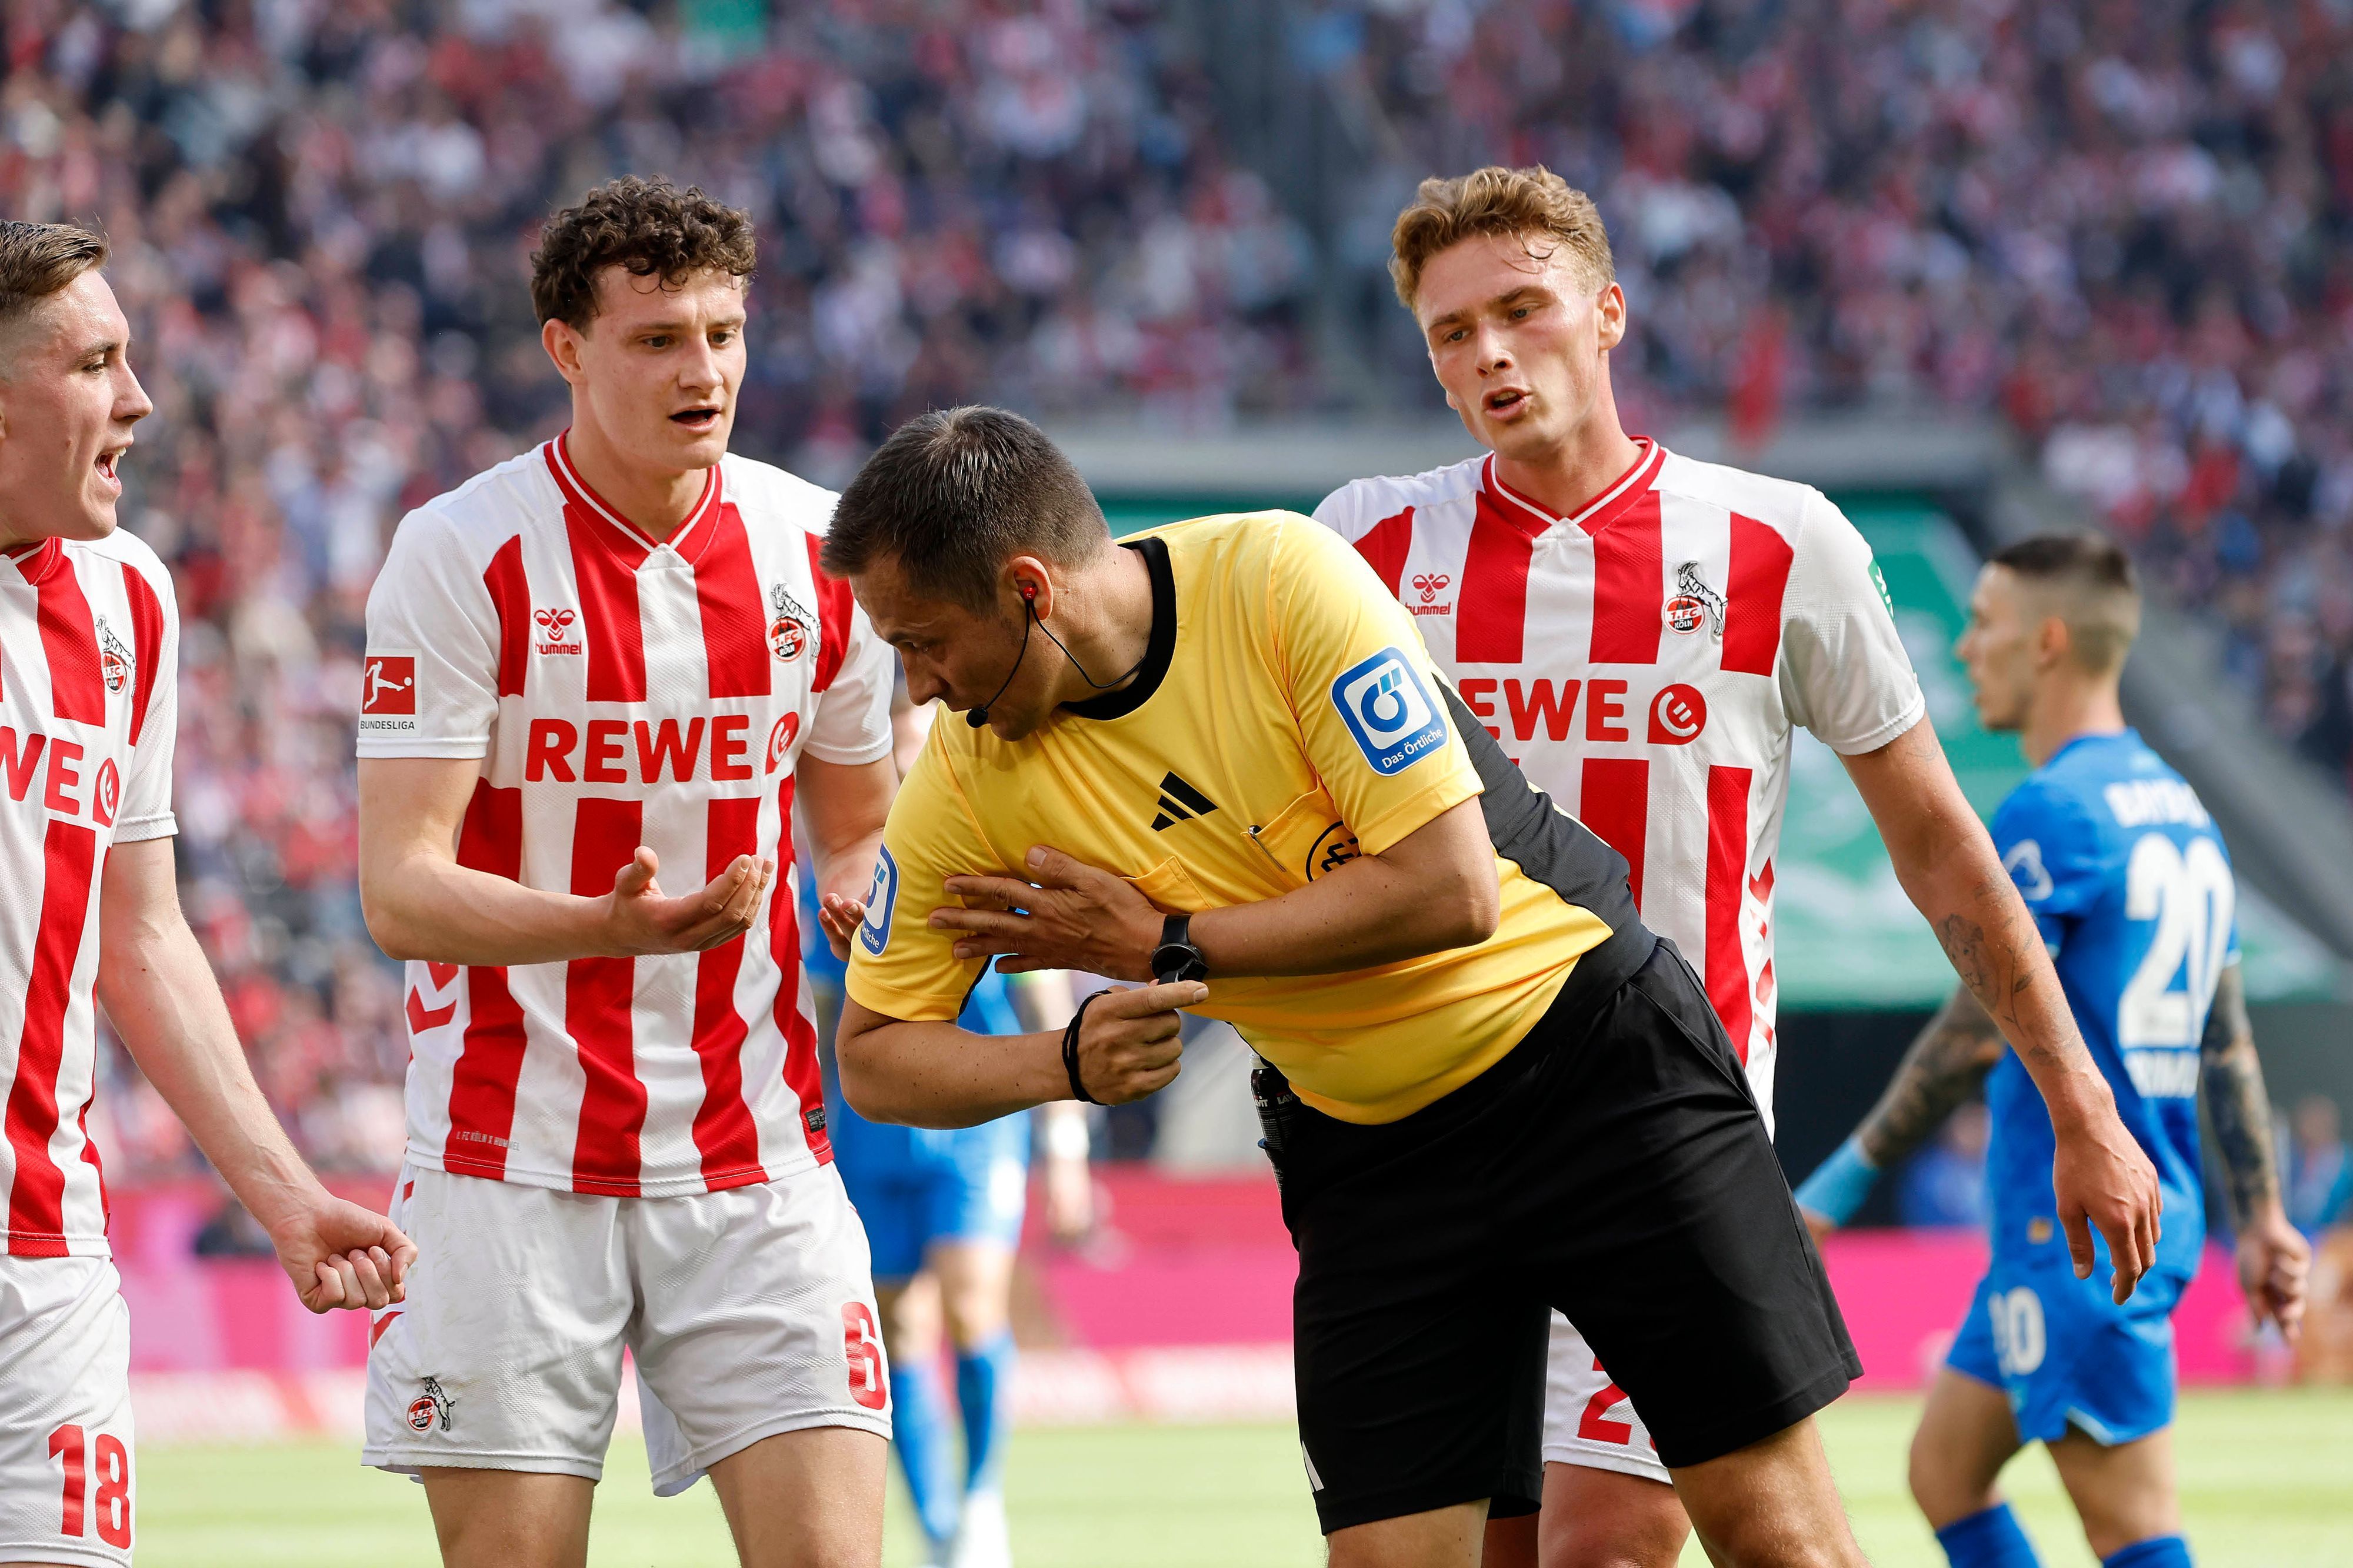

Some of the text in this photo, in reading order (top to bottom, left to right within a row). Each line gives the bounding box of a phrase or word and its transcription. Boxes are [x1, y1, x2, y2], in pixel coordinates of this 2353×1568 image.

[1405, 602, 1451, 616] hummel
[1674, 619, 1693, 629] KÖLN
[535, 640, 582, 655] hummel
[360, 720, 415, 730] BUNDESLIGA
[1459, 679, 1629, 742] EWE
[0, 726, 84, 816] WE
[525, 715, 753, 783] REWE
[1382, 728, 1444, 769] Das Örtliche
[862, 919, 879, 948] rtliche
[2119, 833, 2235, 1047] 20
[841, 1302, 886, 1410] 6
[48, 1424, 131, 1550] 18
